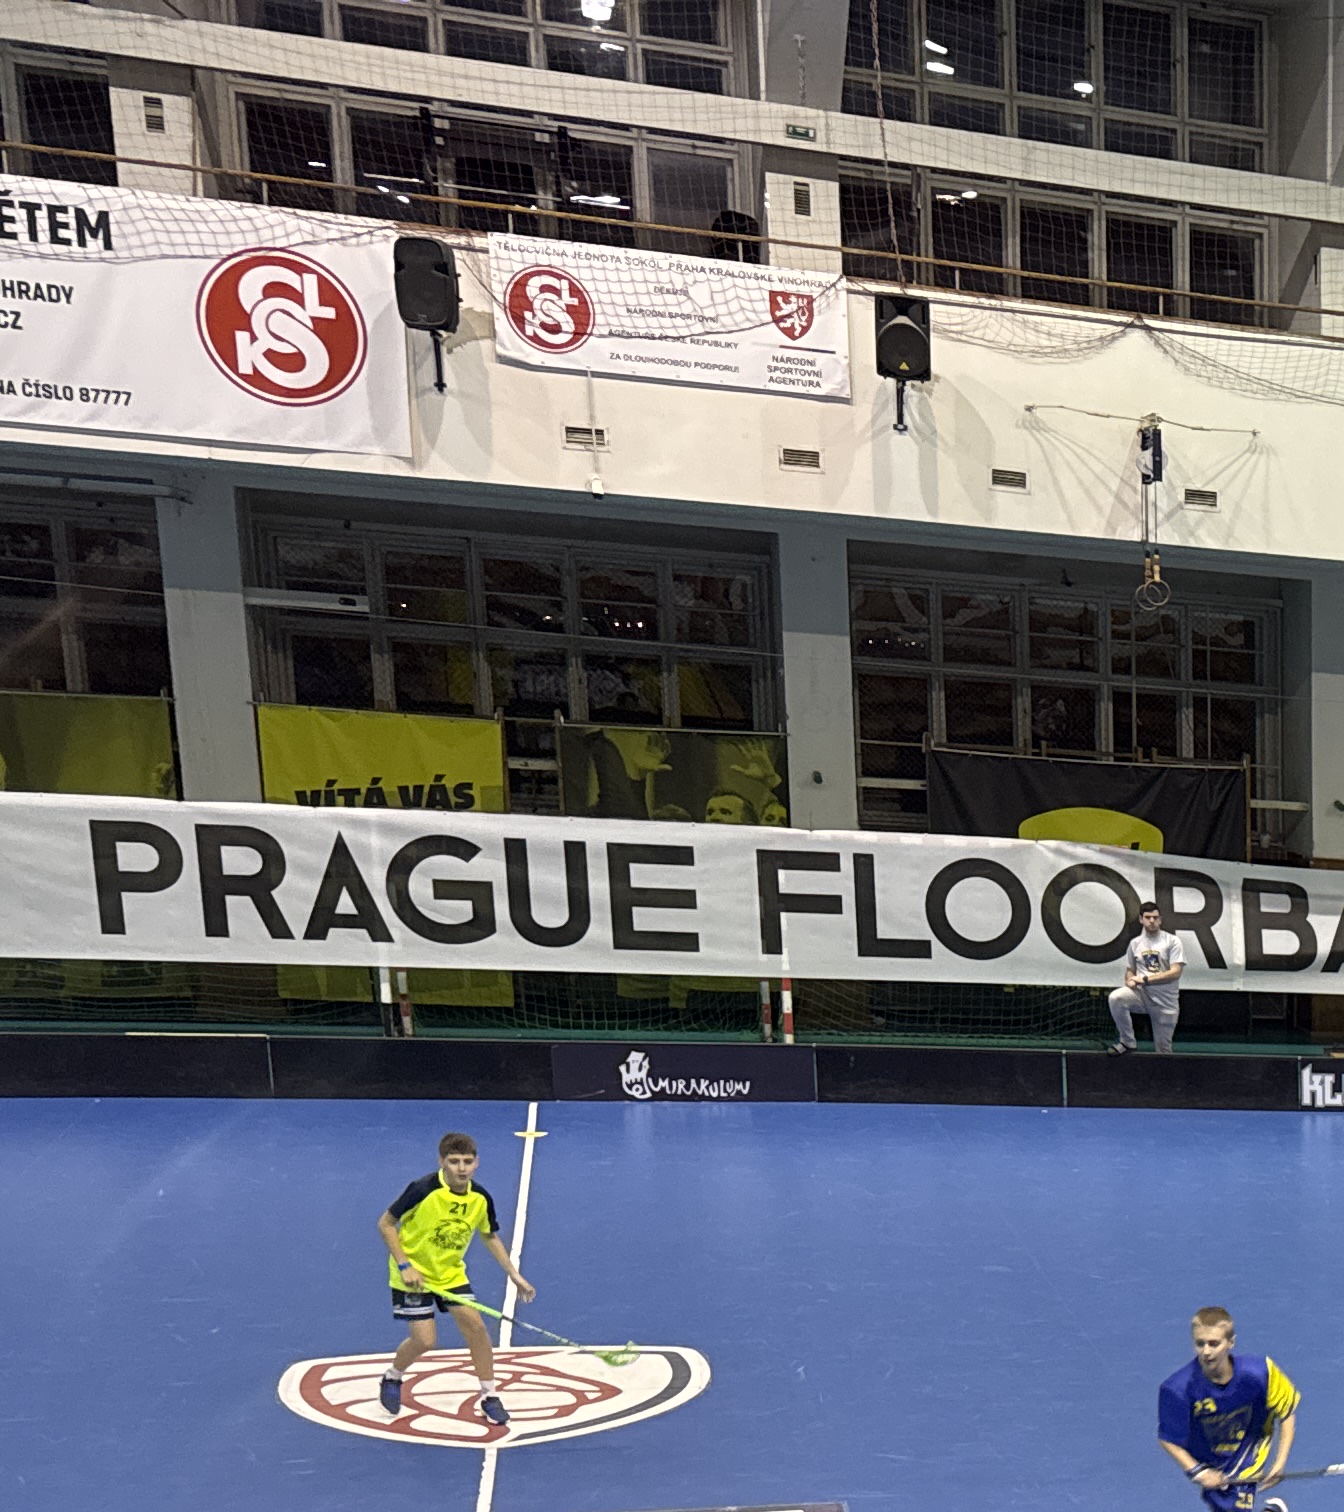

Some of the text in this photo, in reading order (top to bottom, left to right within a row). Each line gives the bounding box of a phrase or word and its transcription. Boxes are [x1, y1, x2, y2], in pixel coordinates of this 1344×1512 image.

[572, 250, 623, 265] JEDNOTA
[2, 279, 74, 305] HRADY
[690, 337, 739, 350] REPUBLIKY
[609, 352, 622, 362] ZA
[767, 376, 823, 389] AGENTURA
[21, 378, 73, 402] ČÍSLO
[79, 387, 132, 407] 87777
[397, 774, 476, 810] VÁS
[88, 818, 700, 953] PRAGUE
[448, 1201, 468, 1216] 21
